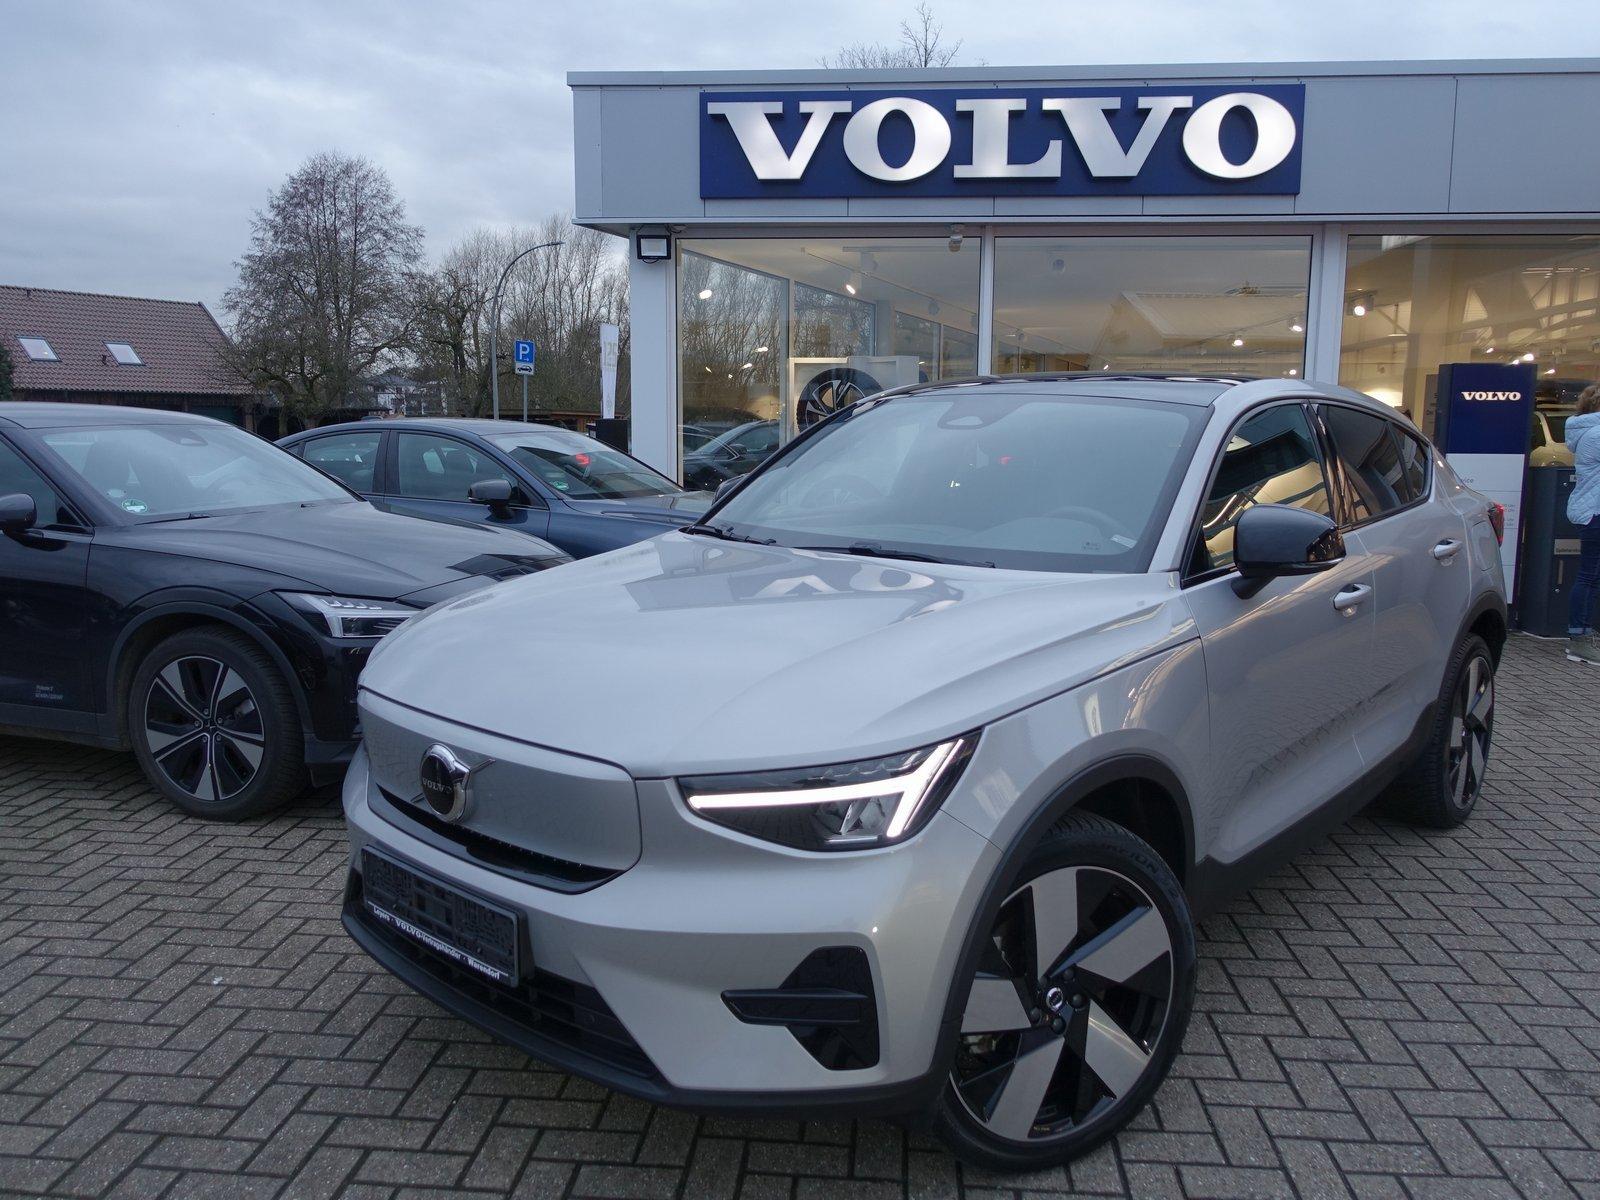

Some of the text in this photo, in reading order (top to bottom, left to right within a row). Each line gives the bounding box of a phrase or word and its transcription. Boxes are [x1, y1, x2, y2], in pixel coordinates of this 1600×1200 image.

[707, 92, 1297, 182] VOLVO
[519, 343, 530, 361] P
[1461, 391, 1521, 401] VOLVO
[422, 777, 453, 794] VOLVO
